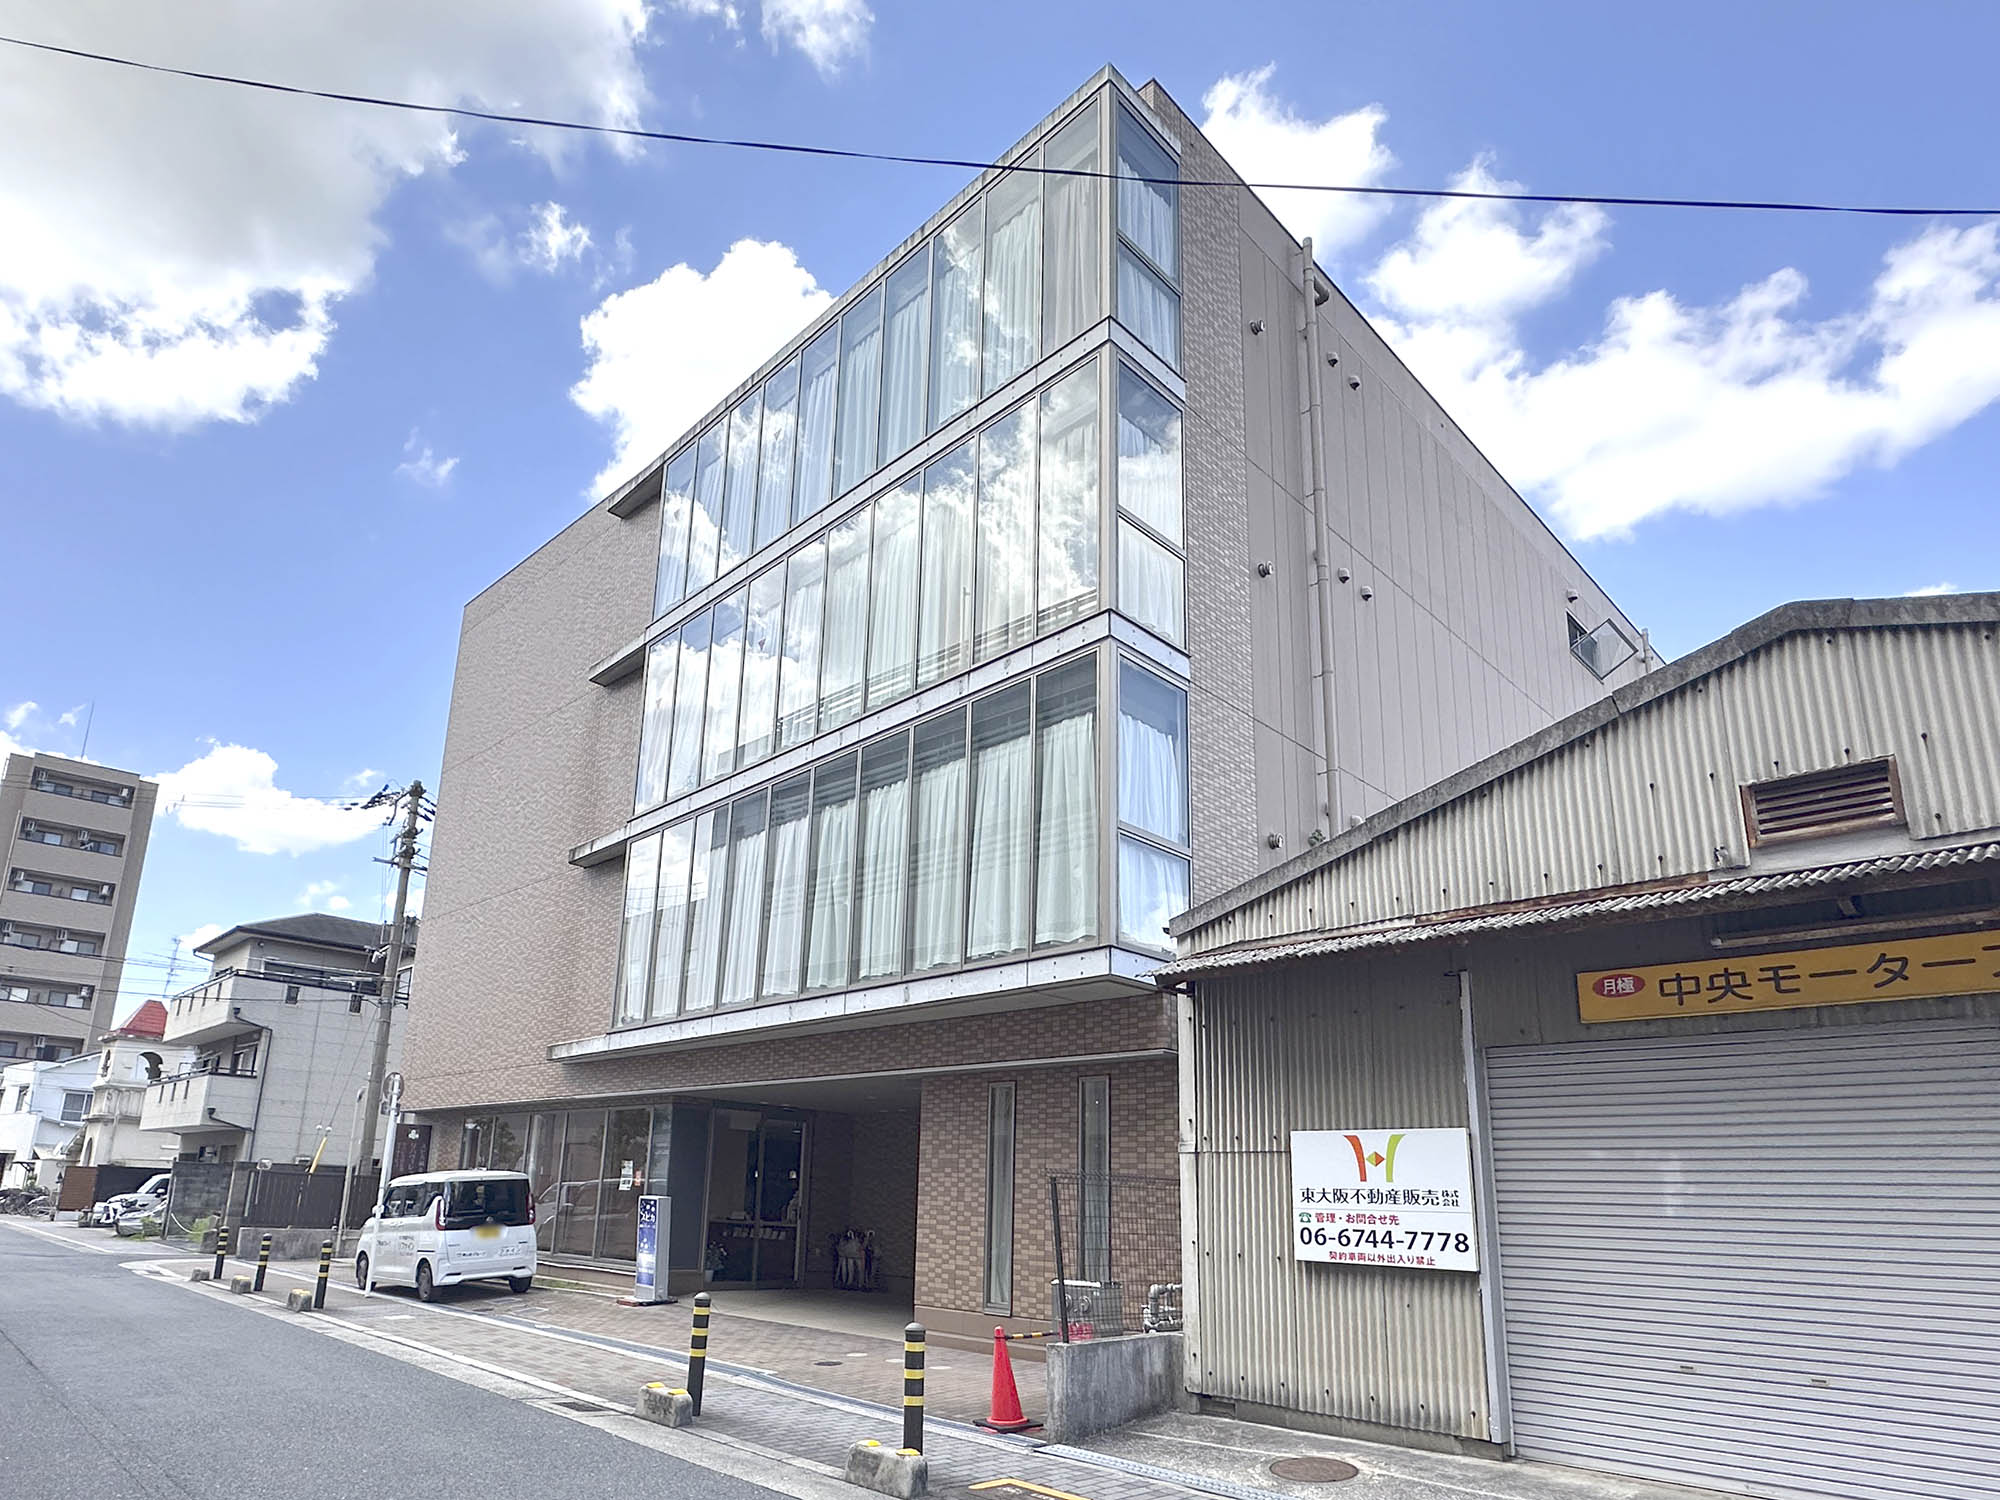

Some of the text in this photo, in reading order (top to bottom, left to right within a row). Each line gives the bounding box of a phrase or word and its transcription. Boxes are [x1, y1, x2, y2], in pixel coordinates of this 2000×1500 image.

[1603, 976, 1635, 995] 月極
[1299, 1226, 1470, 1253] 06-6744-7778
[1328, 1251, 1436, 1266] 契約車両以外出入り禁止
